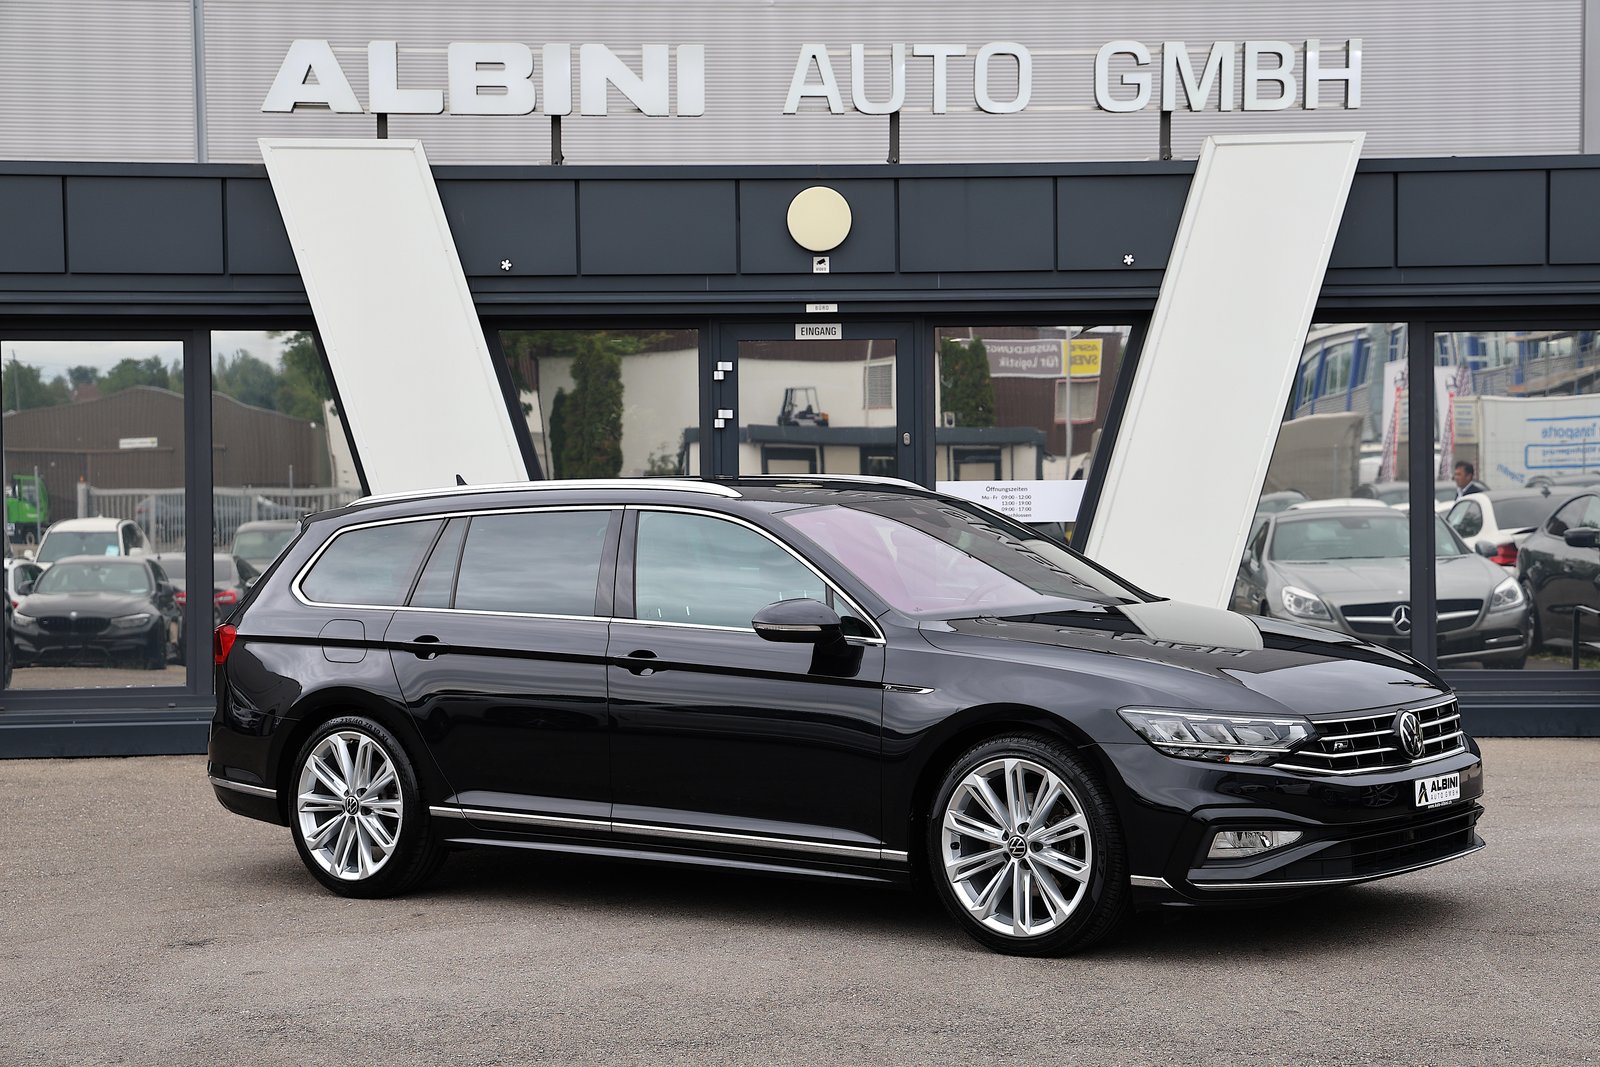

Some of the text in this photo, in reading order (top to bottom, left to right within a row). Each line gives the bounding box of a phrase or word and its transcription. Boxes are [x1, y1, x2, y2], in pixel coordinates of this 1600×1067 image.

[261, 39, 1362, 116] ALBINI AUTO GMBH
[800, 326, 837, 336] EINGANG
[1431, 776, 1458, 793] ALBINI
[1430, 792, 1444, 800] AUTO
